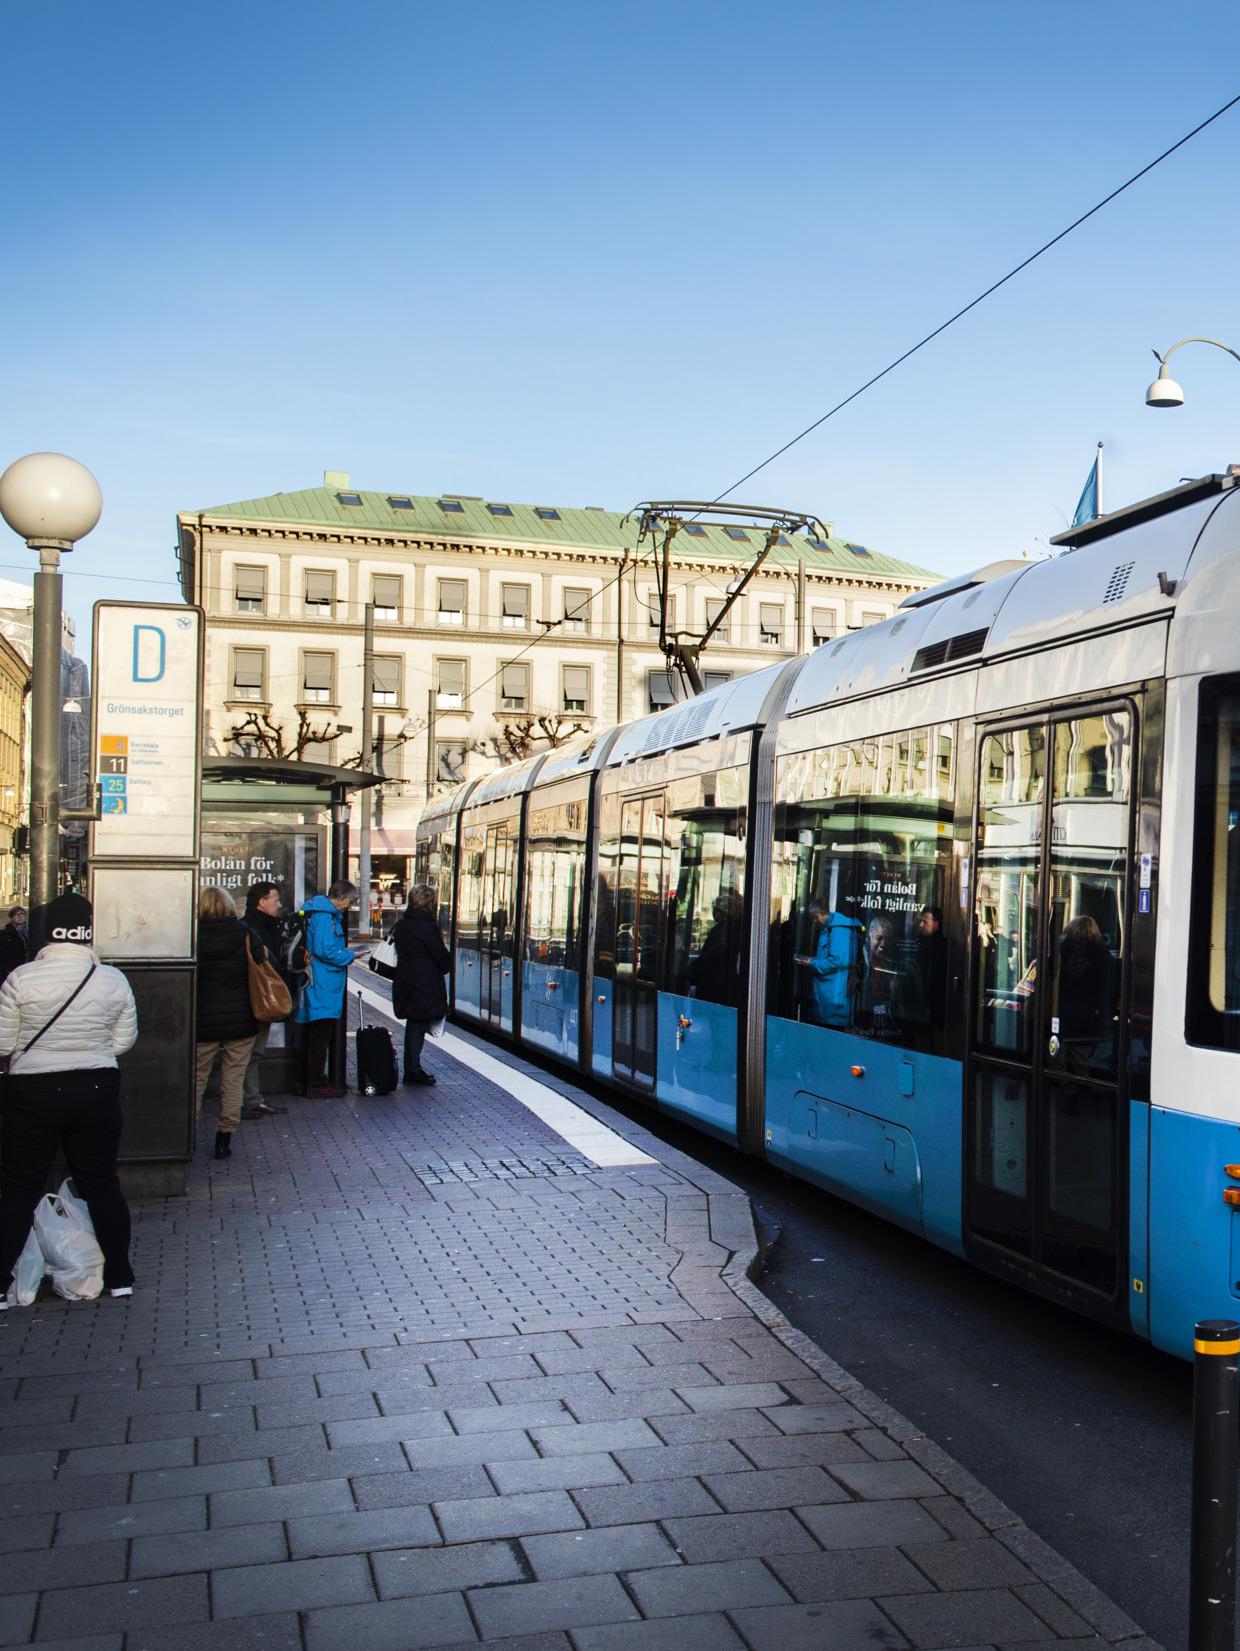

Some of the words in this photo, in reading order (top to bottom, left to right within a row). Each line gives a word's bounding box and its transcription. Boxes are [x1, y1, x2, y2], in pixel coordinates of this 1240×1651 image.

[132, 624, 166, 683] D
[107, 703, 184, 718] Grönsakstorget
[110, 758, 125, 772] 11
[109, 779, 124, 792] 25
[200, 855, 245, 870] Bolån
[250, 856, 275, 870] för
